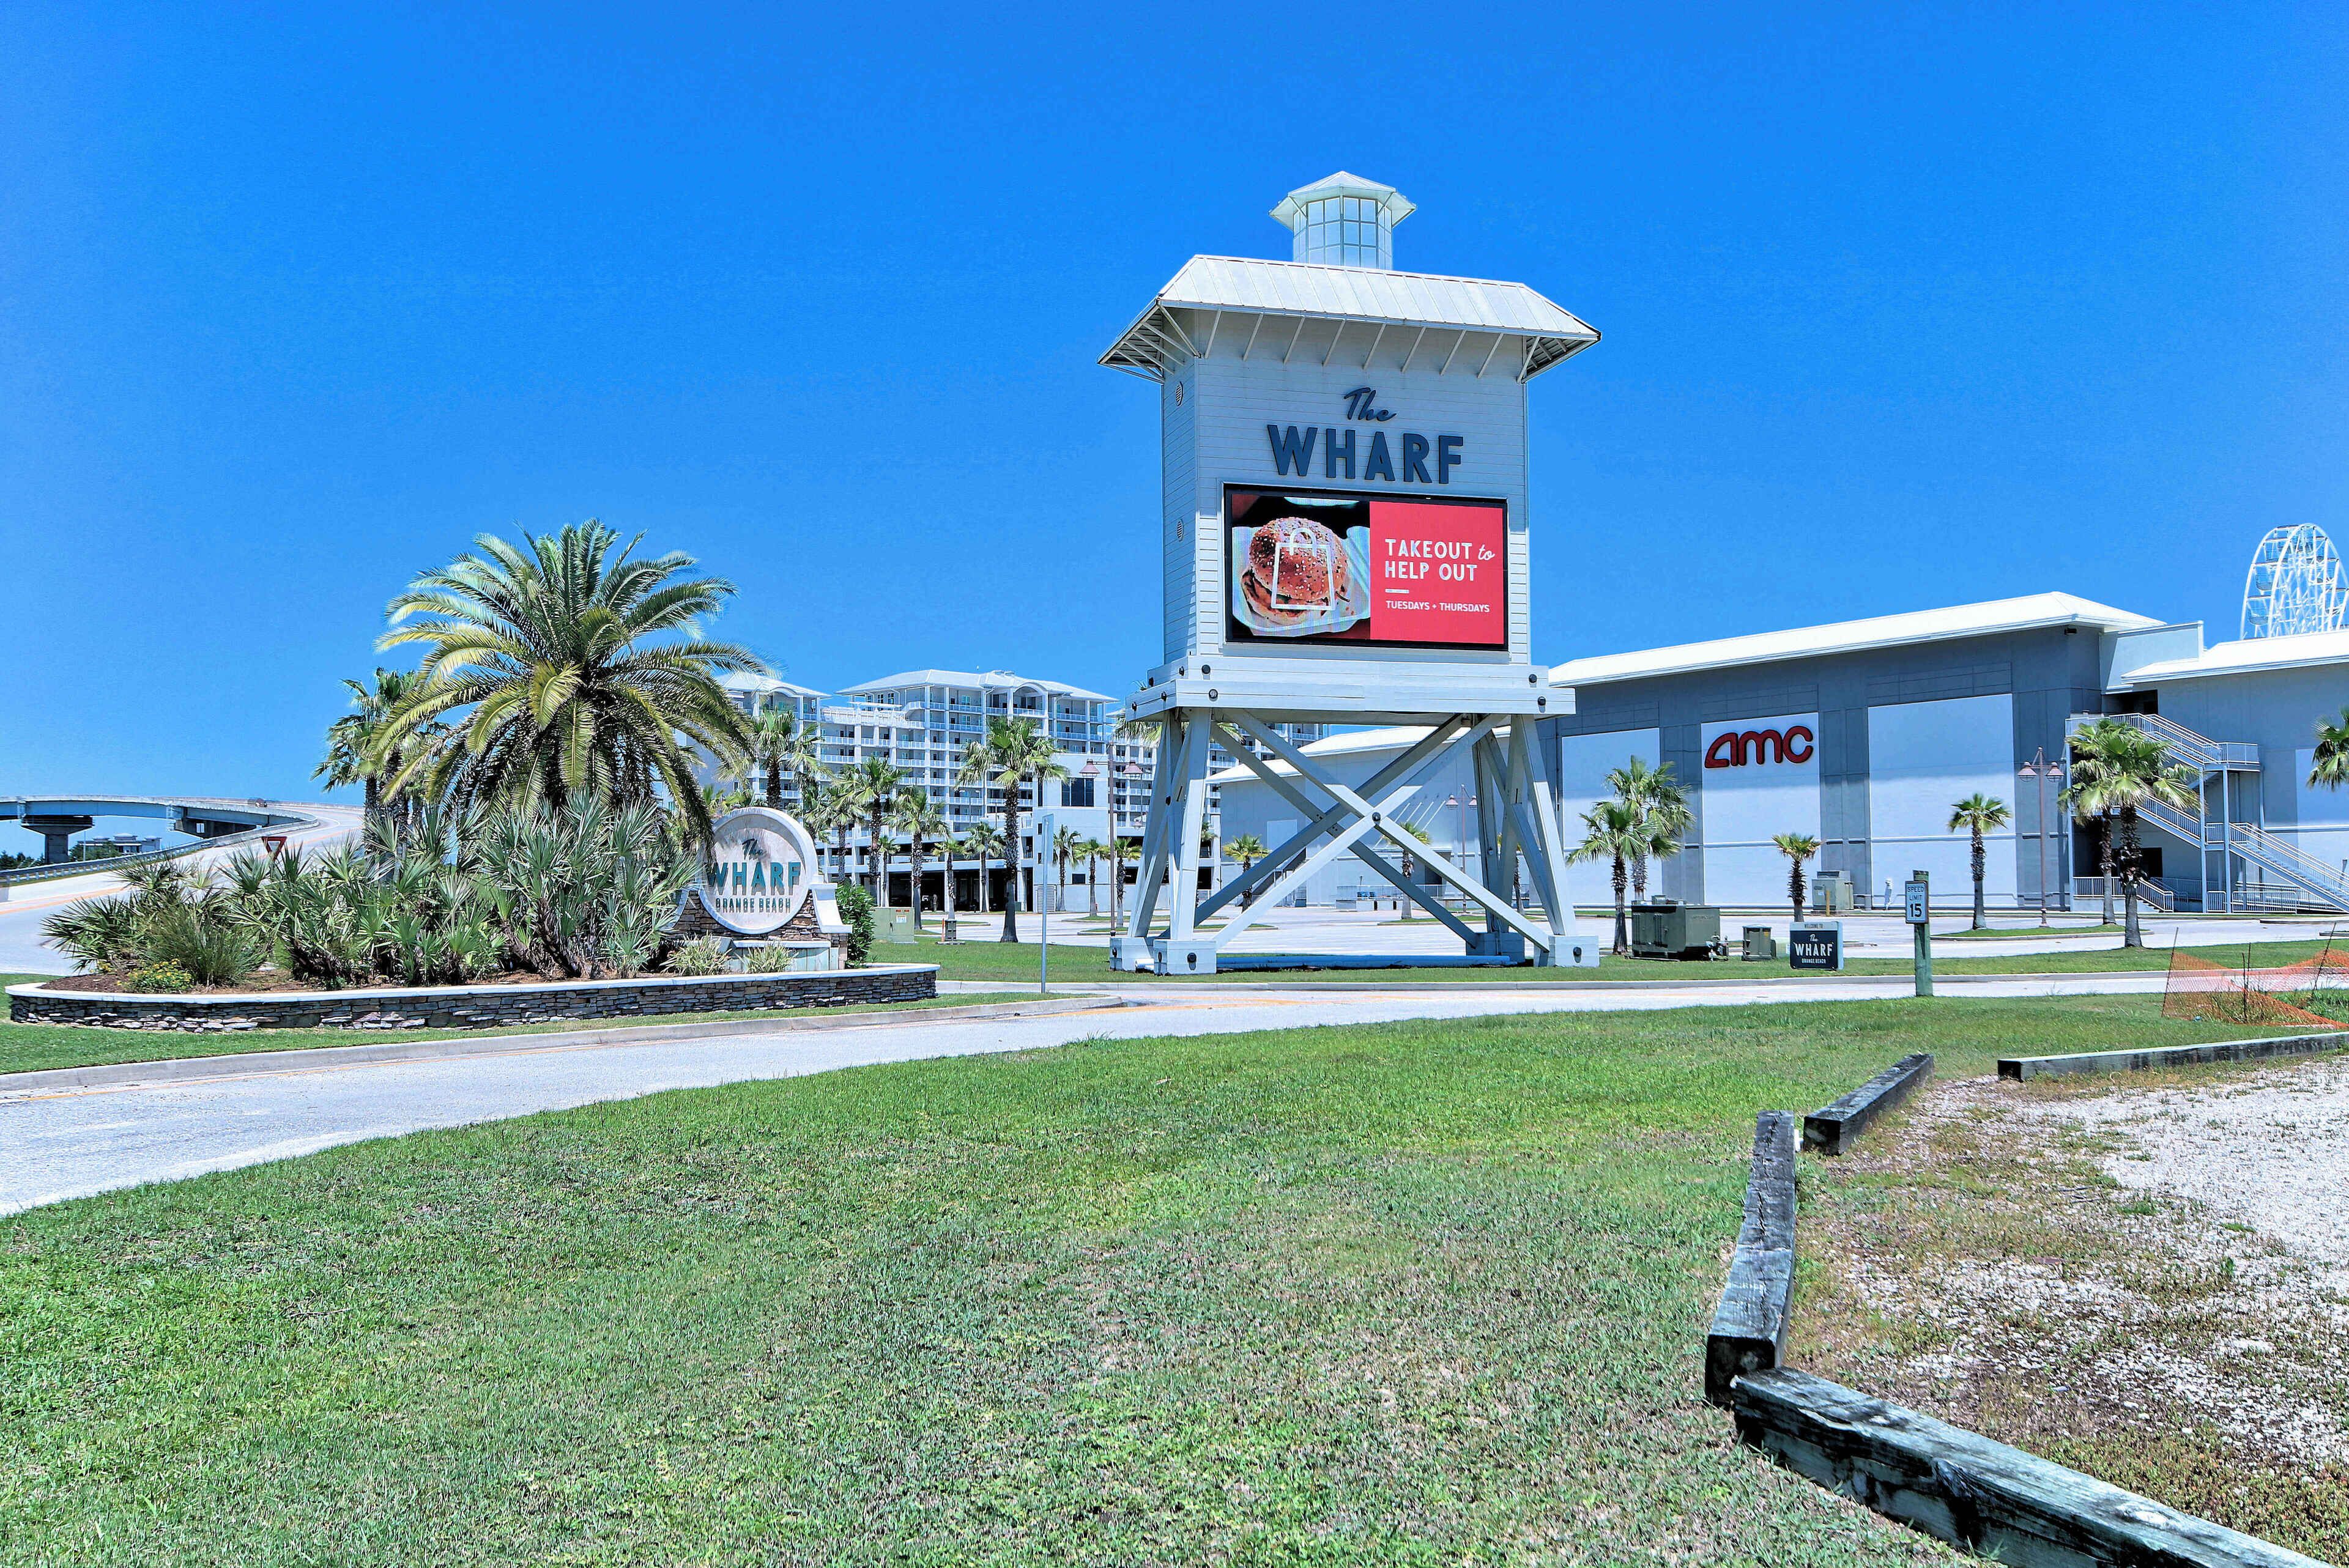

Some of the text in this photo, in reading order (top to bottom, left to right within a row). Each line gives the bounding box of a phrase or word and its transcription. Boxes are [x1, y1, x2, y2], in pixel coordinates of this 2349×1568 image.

[1344, 387, 1397, 421] The
[1267, 424, 1464, 484] WHARF
[1385, 538, 1496, 561] TAKEOUT to
[1385, 560, 1477, 582] HELP OUT
[1386, 600, 1430, 610] TUESDAYS
[1439, 602, 1490, 613] THURSDAYS
[741, 838, 766, 857] The
[706, 862, 801, 888] WHARF
[715, 898, 791, 909] ORANGE BEACH
[1910, 903, 1922, 917] 15
[1795, 943, 1833, 956] WHARF
